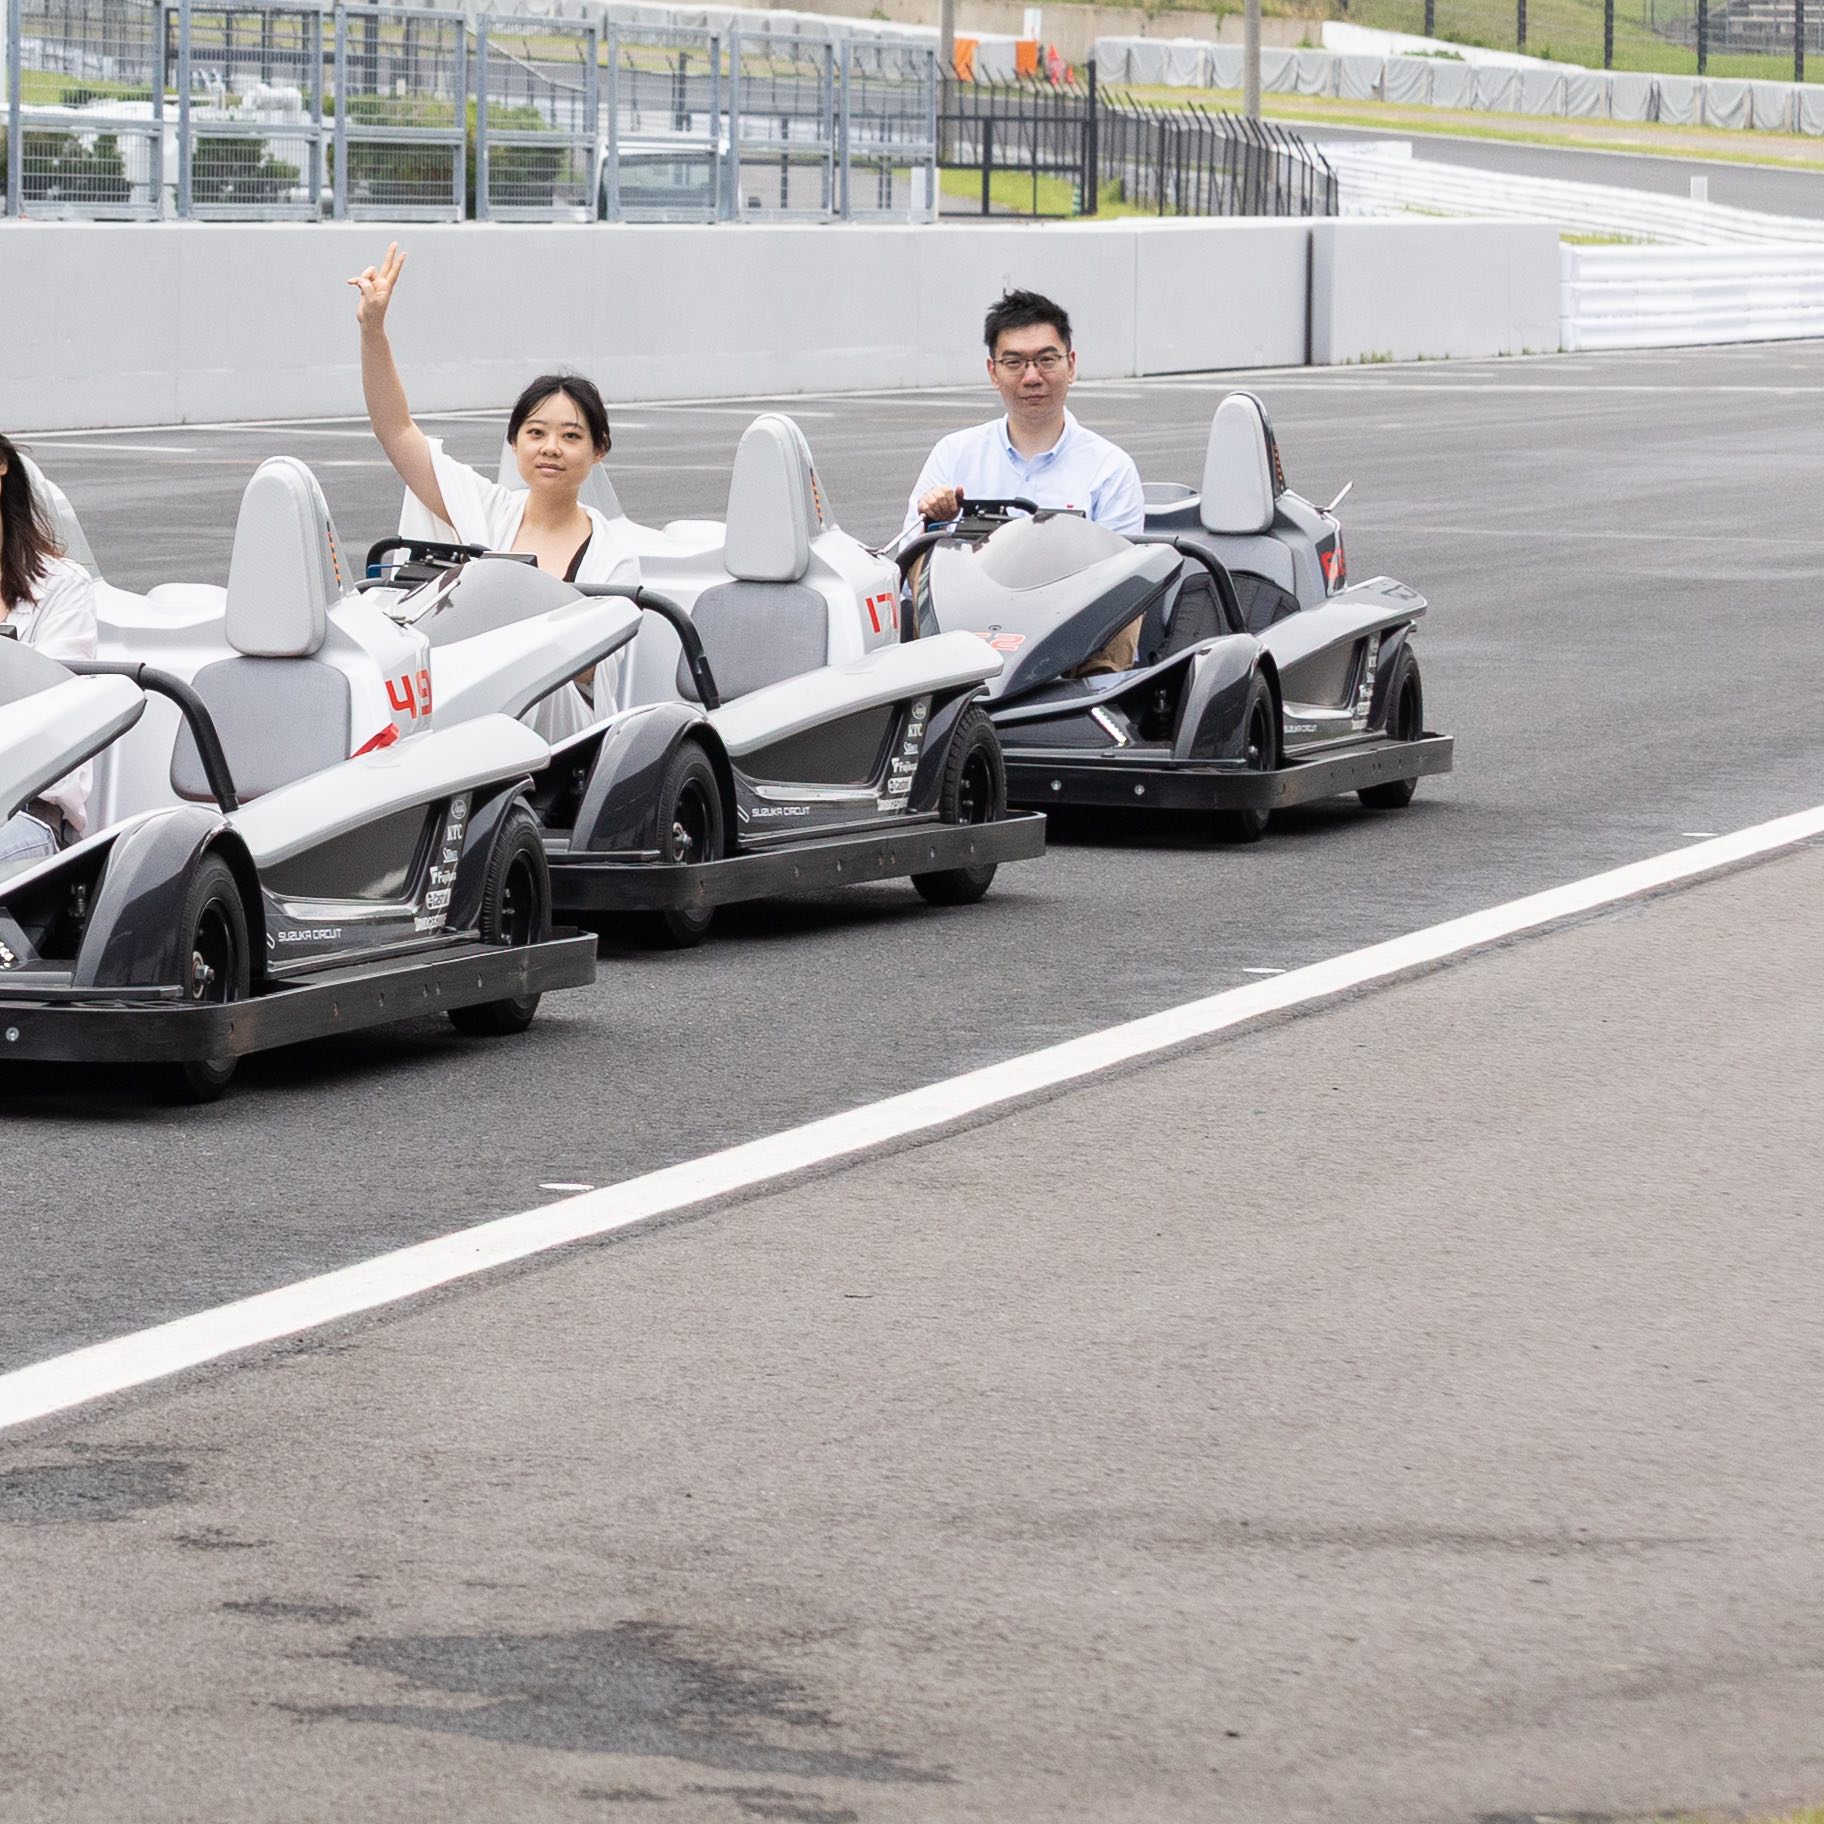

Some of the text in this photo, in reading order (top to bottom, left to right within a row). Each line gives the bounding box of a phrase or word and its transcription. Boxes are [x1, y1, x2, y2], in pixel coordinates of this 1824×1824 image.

[865, 592, 898, 633] 17
[385, 668, 432, 720] 49
[752, 807, 783, 818] SUZUKA
[278, 928, 342, 942] SUZUKA CIRCUIT
